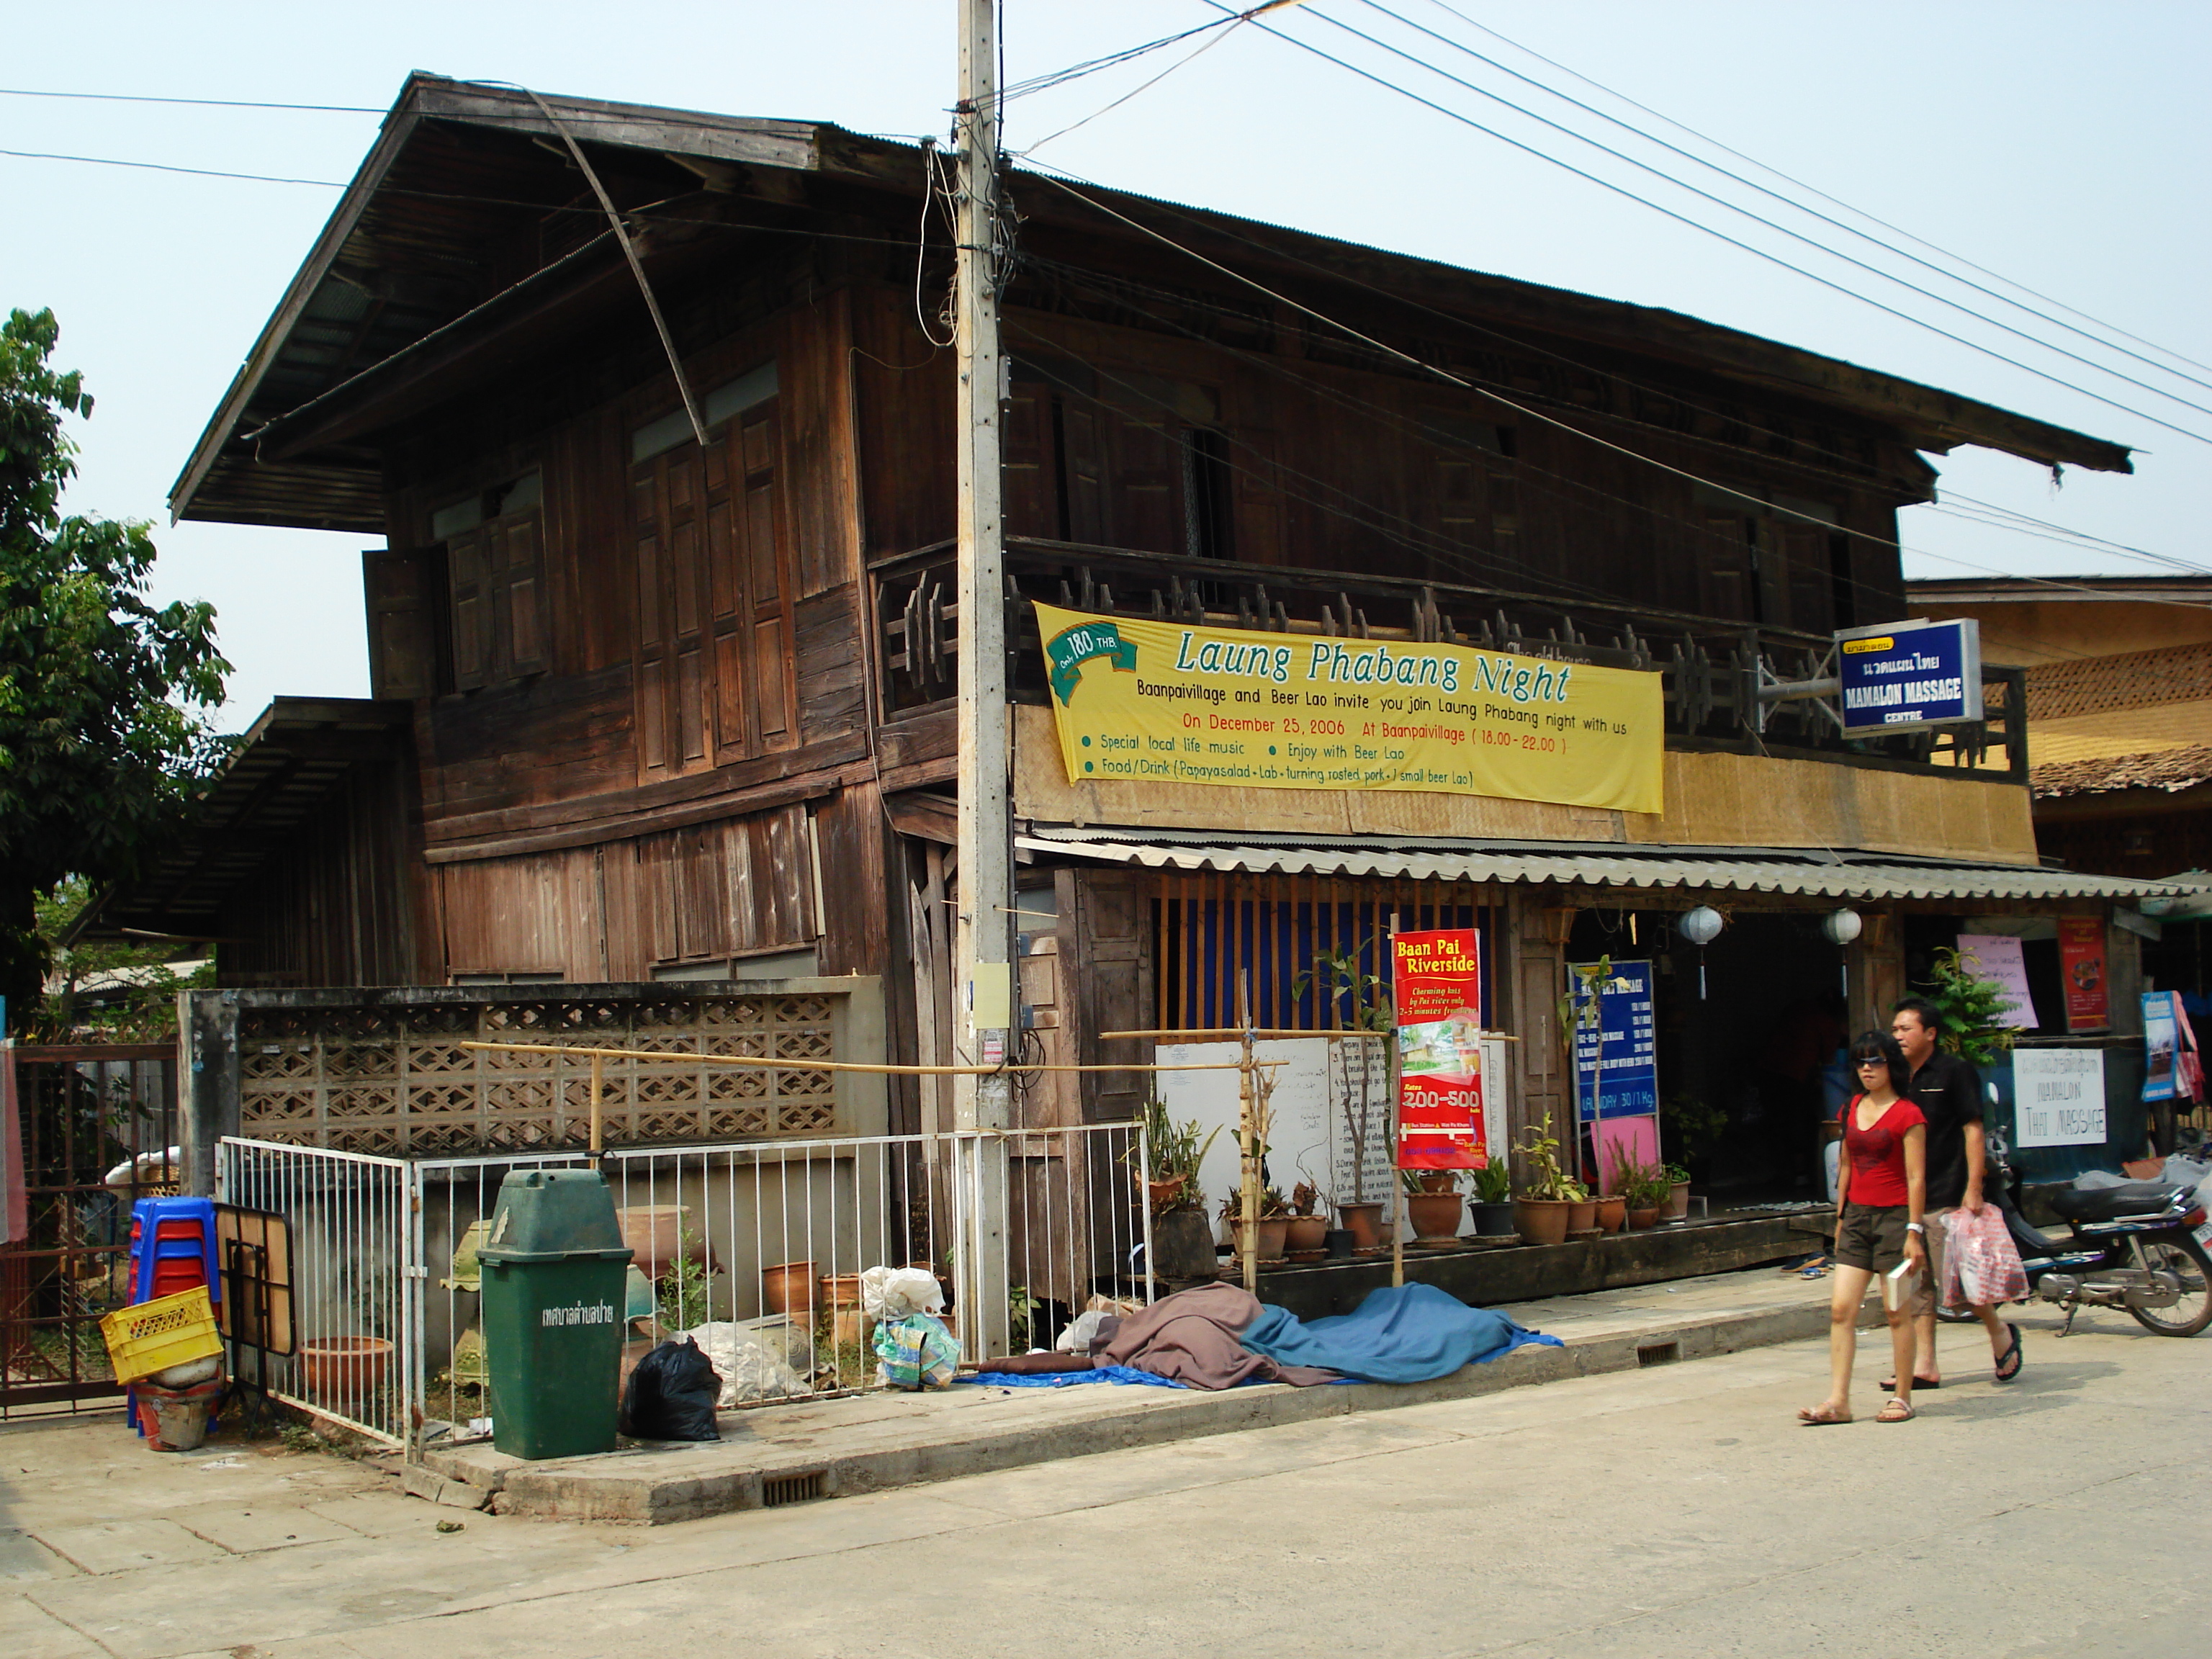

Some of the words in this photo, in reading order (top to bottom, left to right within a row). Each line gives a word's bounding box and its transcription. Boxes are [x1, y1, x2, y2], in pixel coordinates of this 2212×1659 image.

[1067, 631, 1093, 659] 180
[1175, 631, 1292, 684] Laung
[1307, 642, 1460, 693] Phabang
[1473, 655, 1571, 703] Night
[1137, 679, 1226, 706] Baanpaivillage
[1235, 689, 1260, 703] and
[1271, 688, 1299, 704] Beer
[1306, 691, 1327, 706] Lao
[1334, 693, 1369, 709] invite
[1380, 698, 1403, 712] you
[1408, 696, 1431, 714] join
[1439, 698, 1477, 721] Laung
[1485, 703, 1538, 729] Phabang
[1546, 713, 1575, 732] night
[1583, 717, 1607, 732] with
[1613, 723, 1627, 735] us
[1845, 683, 1903, 710] MAMALON
[1905, 678, 1962, 704] MASSAGE
[1183, 713, 1201, 728] On
[1210, 714, 1275, 732] December
[1283, 718, 1305, 735] 25,
[1310, 719, 1345, 735] 2006
[1362, 722, 1375, 737] At
[1382, 722, 1465, 745] Baanpaivillage
[1884, 710, 1923, 724] CENTRE
[1101, 734, 1139, 752] Special
[1148, 735, 1175, 751] local
[1184, 737, 1201, 752] life
[1209, 740, 1245, 755] music
[1287, 742, 1317, 762] Enjoy
[1323, 745, 1347, 759] with
[1354, 745, 1377, 760] Beer
[1385, 746, 1405, 760] Lao
[1102, 758, 1170, 775] Food/Drink
[1285, 767, 1324, 784] turning
[1328, 768, 1360, 781] rosted
[1400, 768, 1424, 782] small
[1428, 768, 1449, 784] beer
[1397, 941, 1431, 957] Baan
[1437, 939, 1460, 956] Pai
[1406, 955, 1475, 974] Riverside
[1410, 997, 1418, 1007] by
[1419, 997, 1430, 1005] Pai
[1402, 1091, 1480, 1108] 200-500
[2056, 1108, 2105, 1137] MASSAGE
[542, 1298, 613, 1327] เทศบาลตำบลปาย
